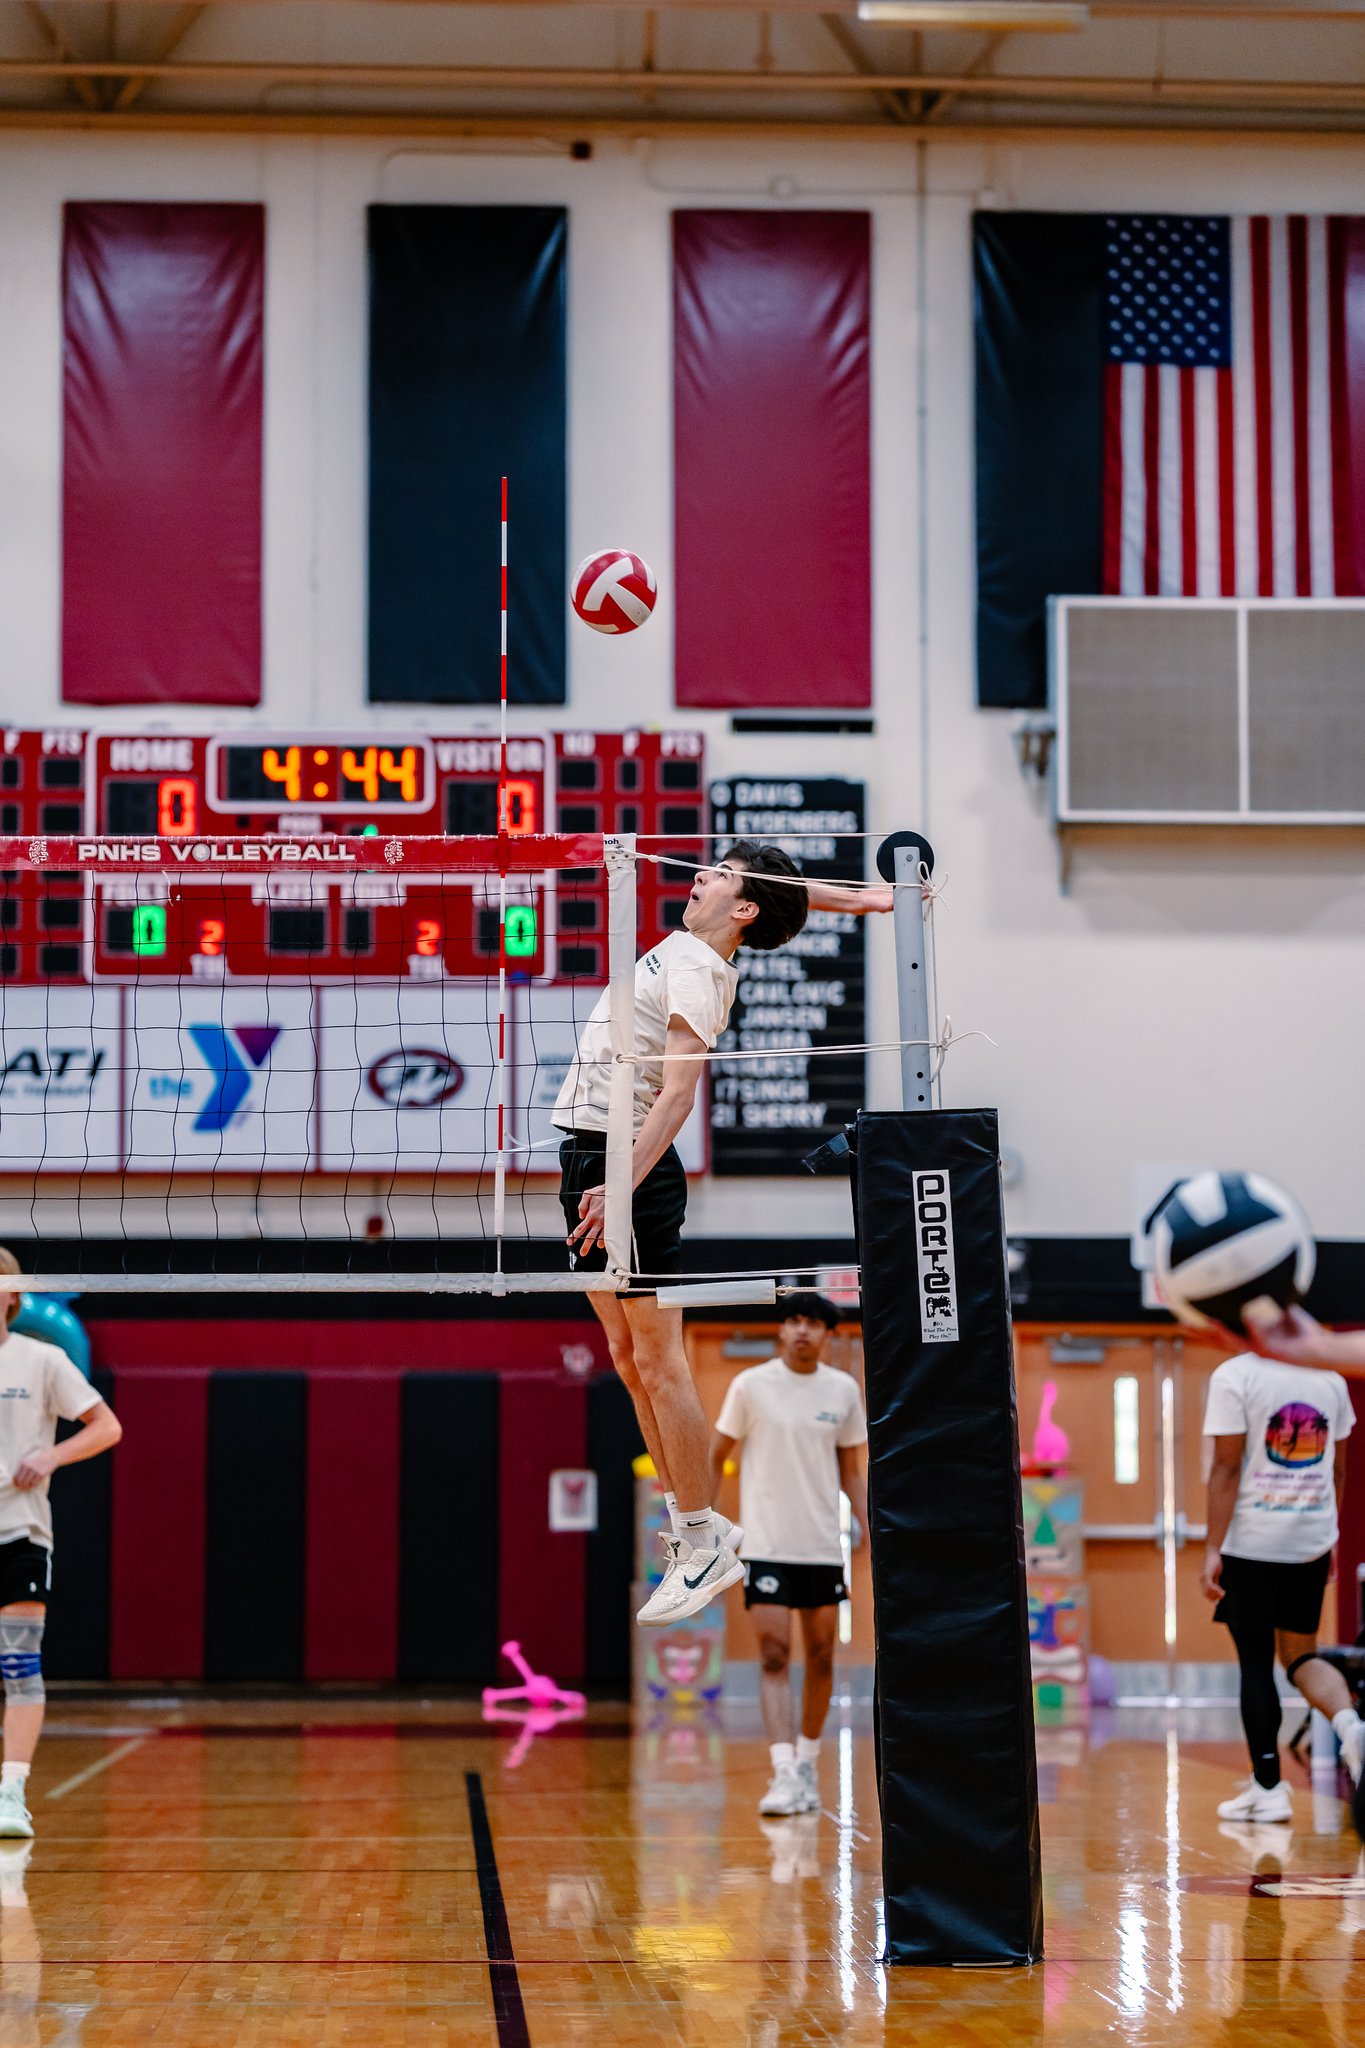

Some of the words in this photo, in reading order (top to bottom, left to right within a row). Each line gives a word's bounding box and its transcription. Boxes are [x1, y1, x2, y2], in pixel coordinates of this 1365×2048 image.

[110, 739, 194, 771] HOME
[262, 745, 416, 802] 4:44
[436, 740, 544, 772] VISITOR
[158, 778, 197, 836] 0
[498, 779, 536, 835] 0
[735, 782, 804, 807] DAVIS
[78, 844, 161, 861] PNHS
[170, 844, 355, 862] VOLLEYBALL
[133, 905, 166, 956] 0
[200, 919, 225, 956] 2
[416, 919, 441, 956] 2
[503, 905, 537, 956] 0
[149, 1075, 193, 1099] the
[741, 1103, 827, 1128] SHERRY
